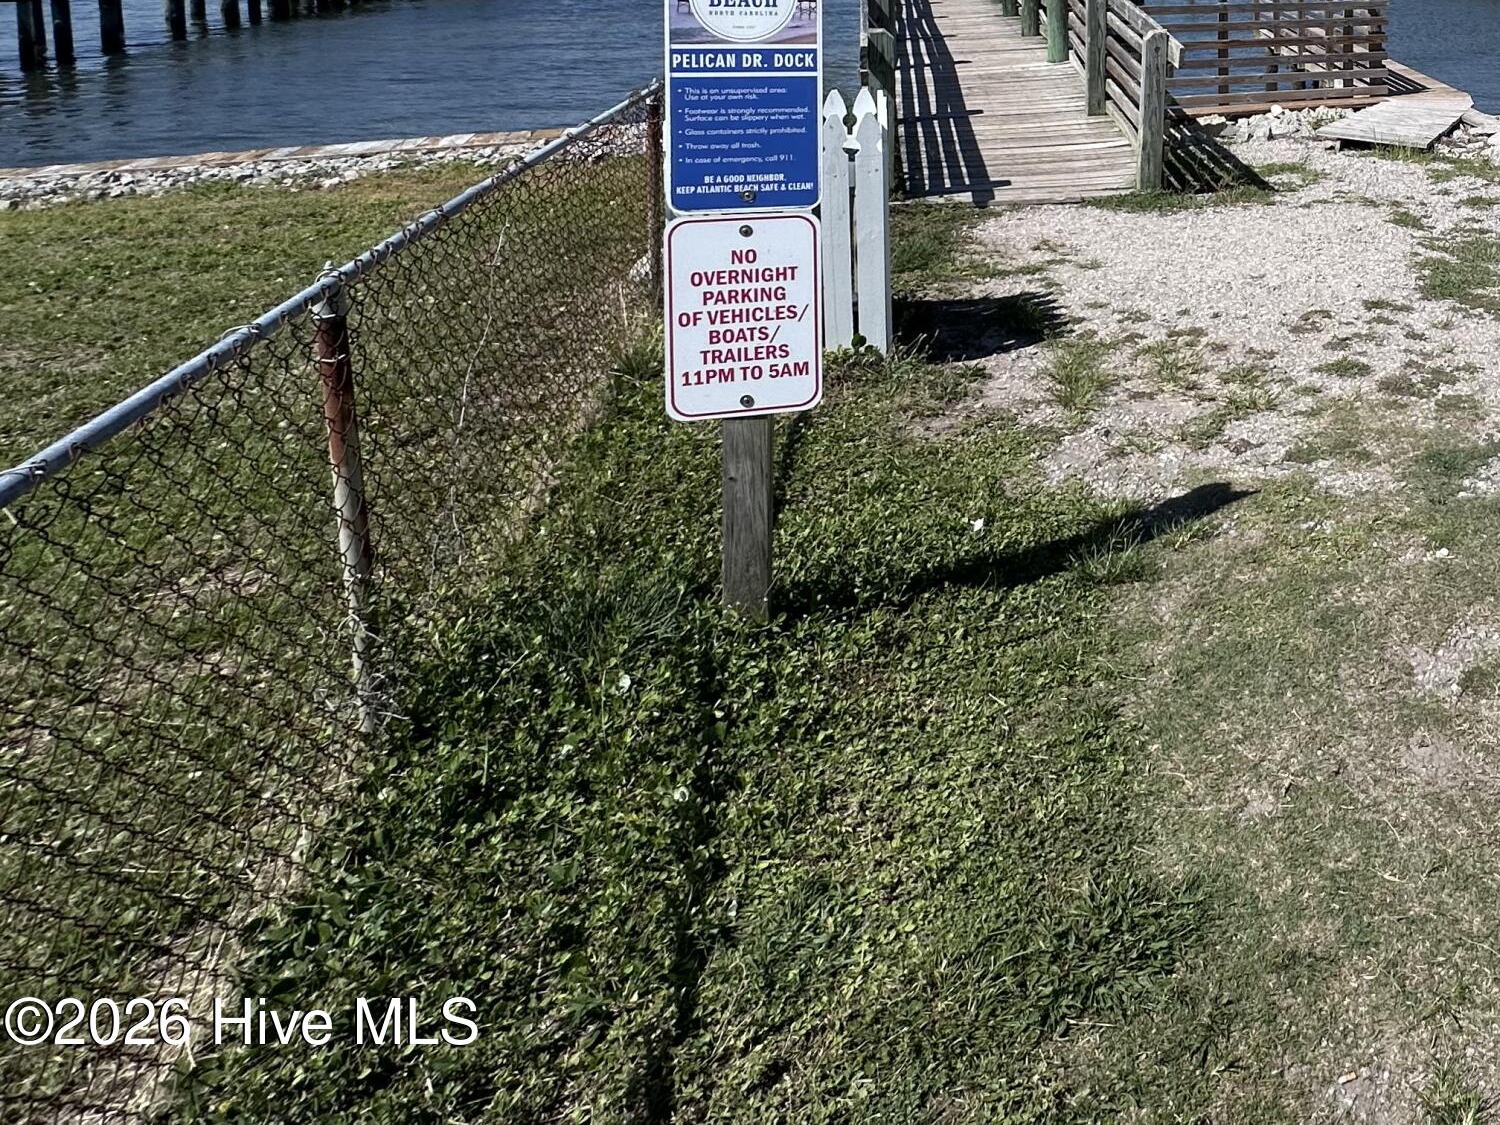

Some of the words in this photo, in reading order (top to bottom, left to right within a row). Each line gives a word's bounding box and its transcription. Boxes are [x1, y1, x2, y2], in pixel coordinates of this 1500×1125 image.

[672, 54, 735, 67] PELICAN
[742, 54, 767, 67] DR.
[774, 53, 814, 67] DOCK
[677, 186, 695, 194] KEEP
[697, 185, 732, 193] ATLANTIC
[734, 184, 758, 192] BEACH
[761, 183, 778, 191] SAFE
[788, 182, 813, 190] CLEAN!
[731, 249, 757, 264] NO
[690, 266, 798, 286] OVERNIGHT
[702, 286, 786, 305] PARKING
[678, 311, 702, 327] OF
[707, 303, 809, 325] VEHICLES/
[709, 325, 780, 344] BOATS/
[700, 344, 790, 365] TRAILERS
[682, 368, 734, 386] 11PM
[740, 366, 762, 381] TO
[769, 361, 809, 378] 5AM
